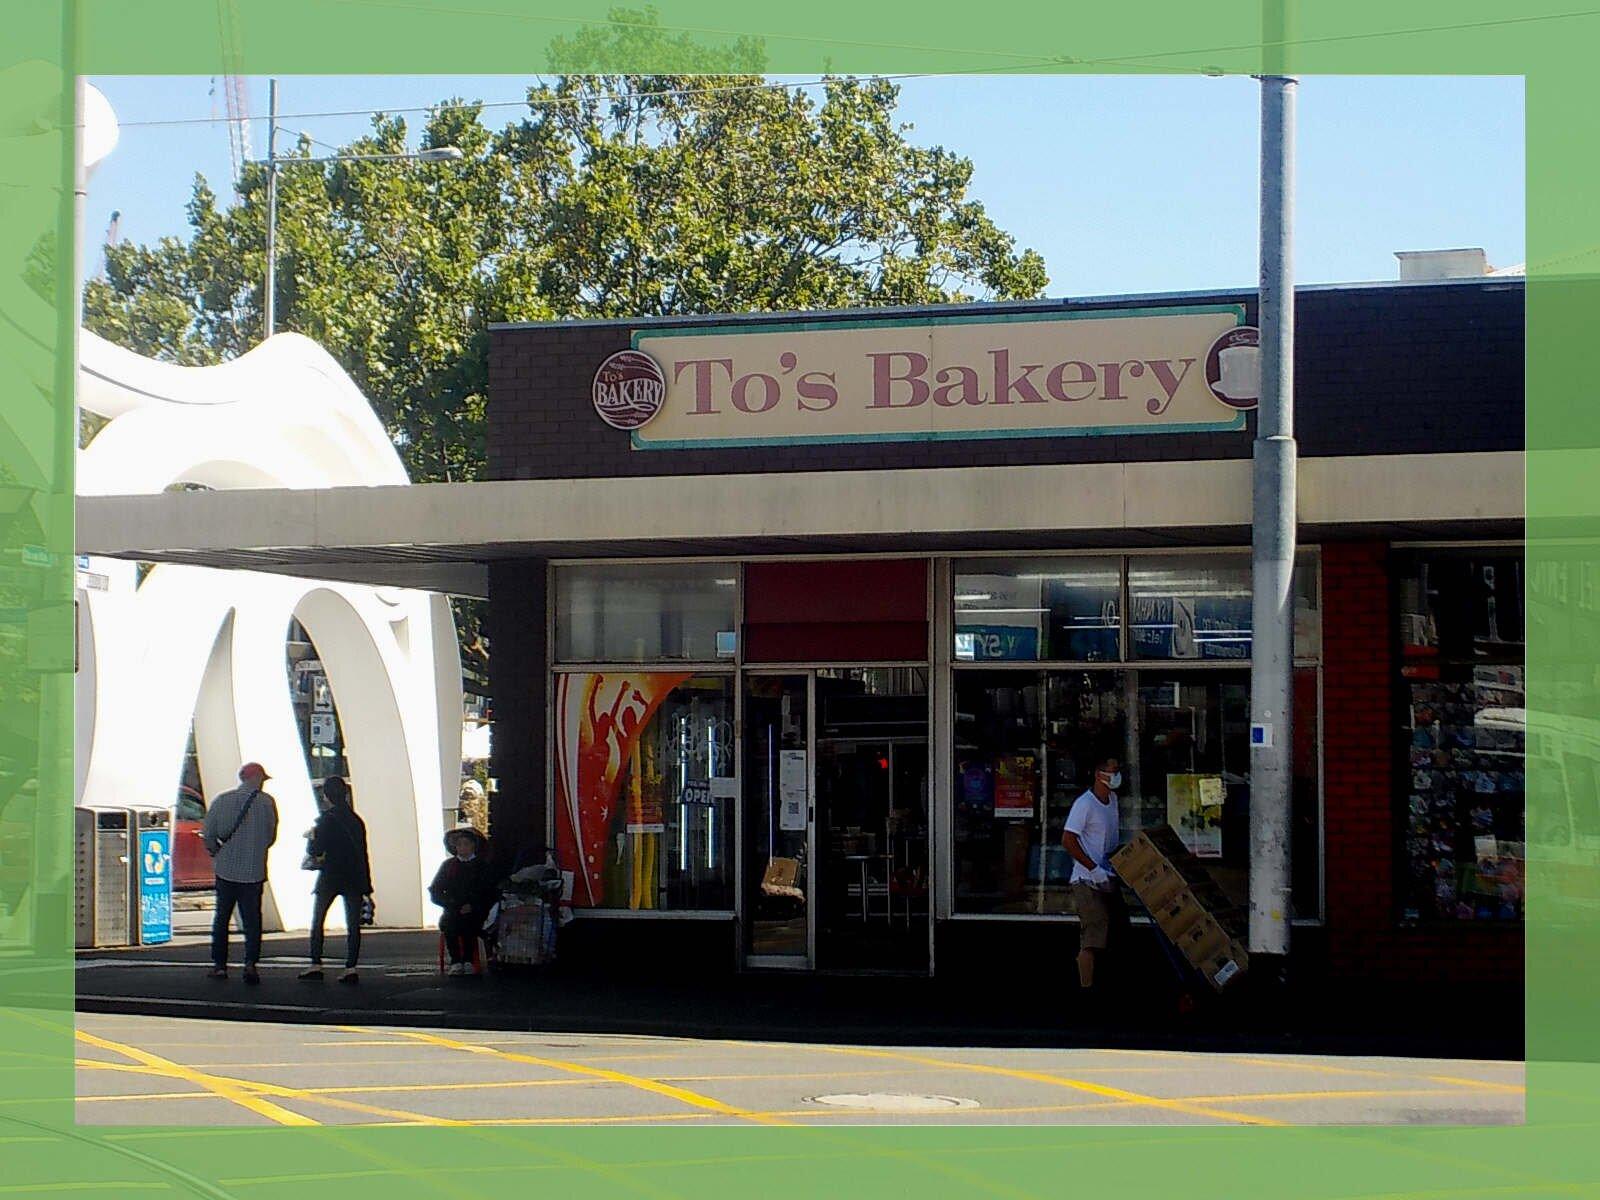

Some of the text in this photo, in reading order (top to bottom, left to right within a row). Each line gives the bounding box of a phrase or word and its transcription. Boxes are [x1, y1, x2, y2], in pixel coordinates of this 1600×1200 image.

[597, 378, 662, 406] BAKERY
[674, 347, 1197, 415] To's Bakery
